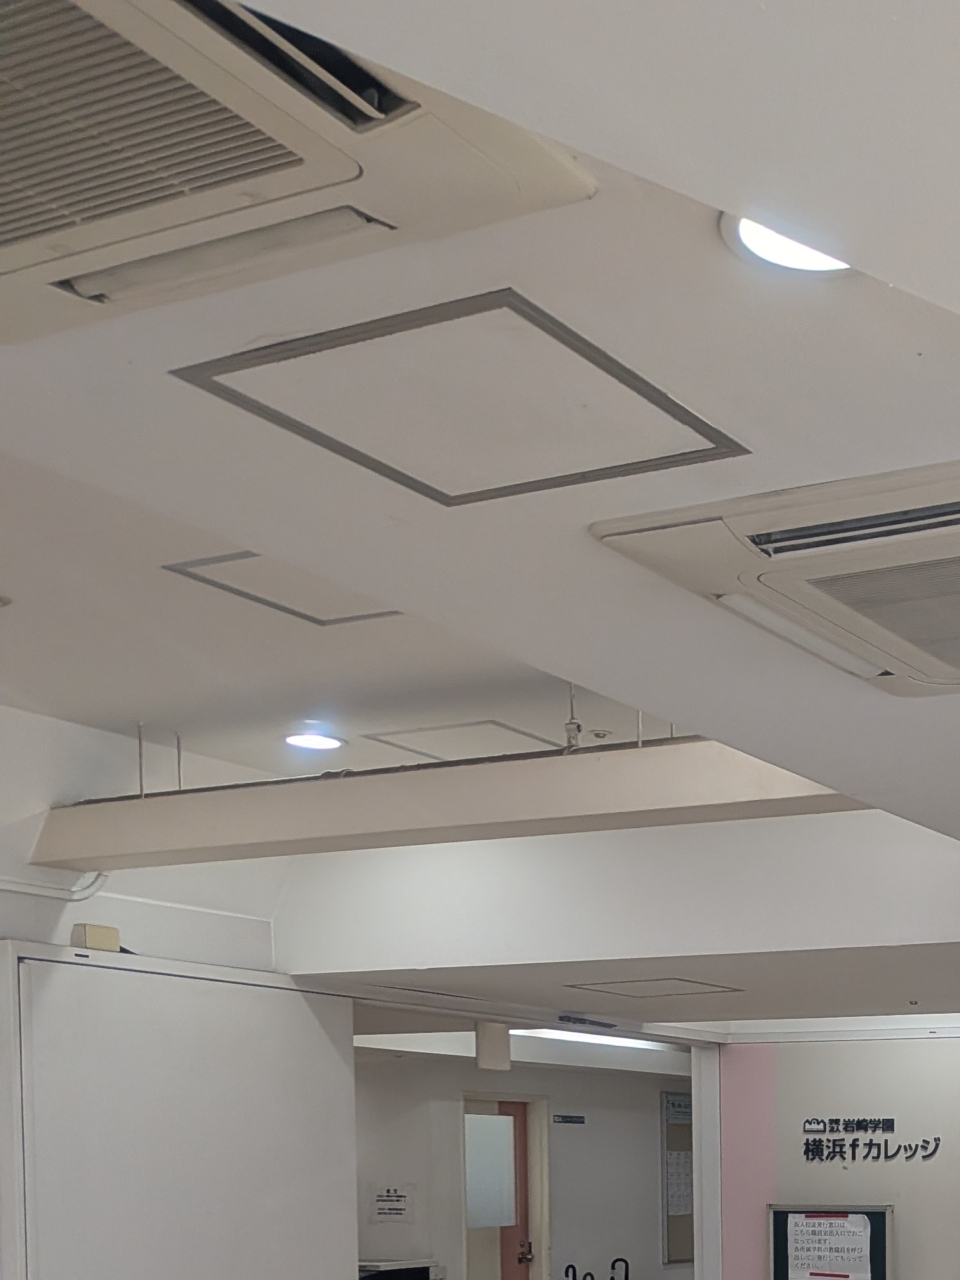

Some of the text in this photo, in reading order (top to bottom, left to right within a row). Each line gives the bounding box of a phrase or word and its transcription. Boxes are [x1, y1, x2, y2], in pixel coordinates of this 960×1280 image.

[803, 1137, 941, 1161] 横浜fカレッジ
